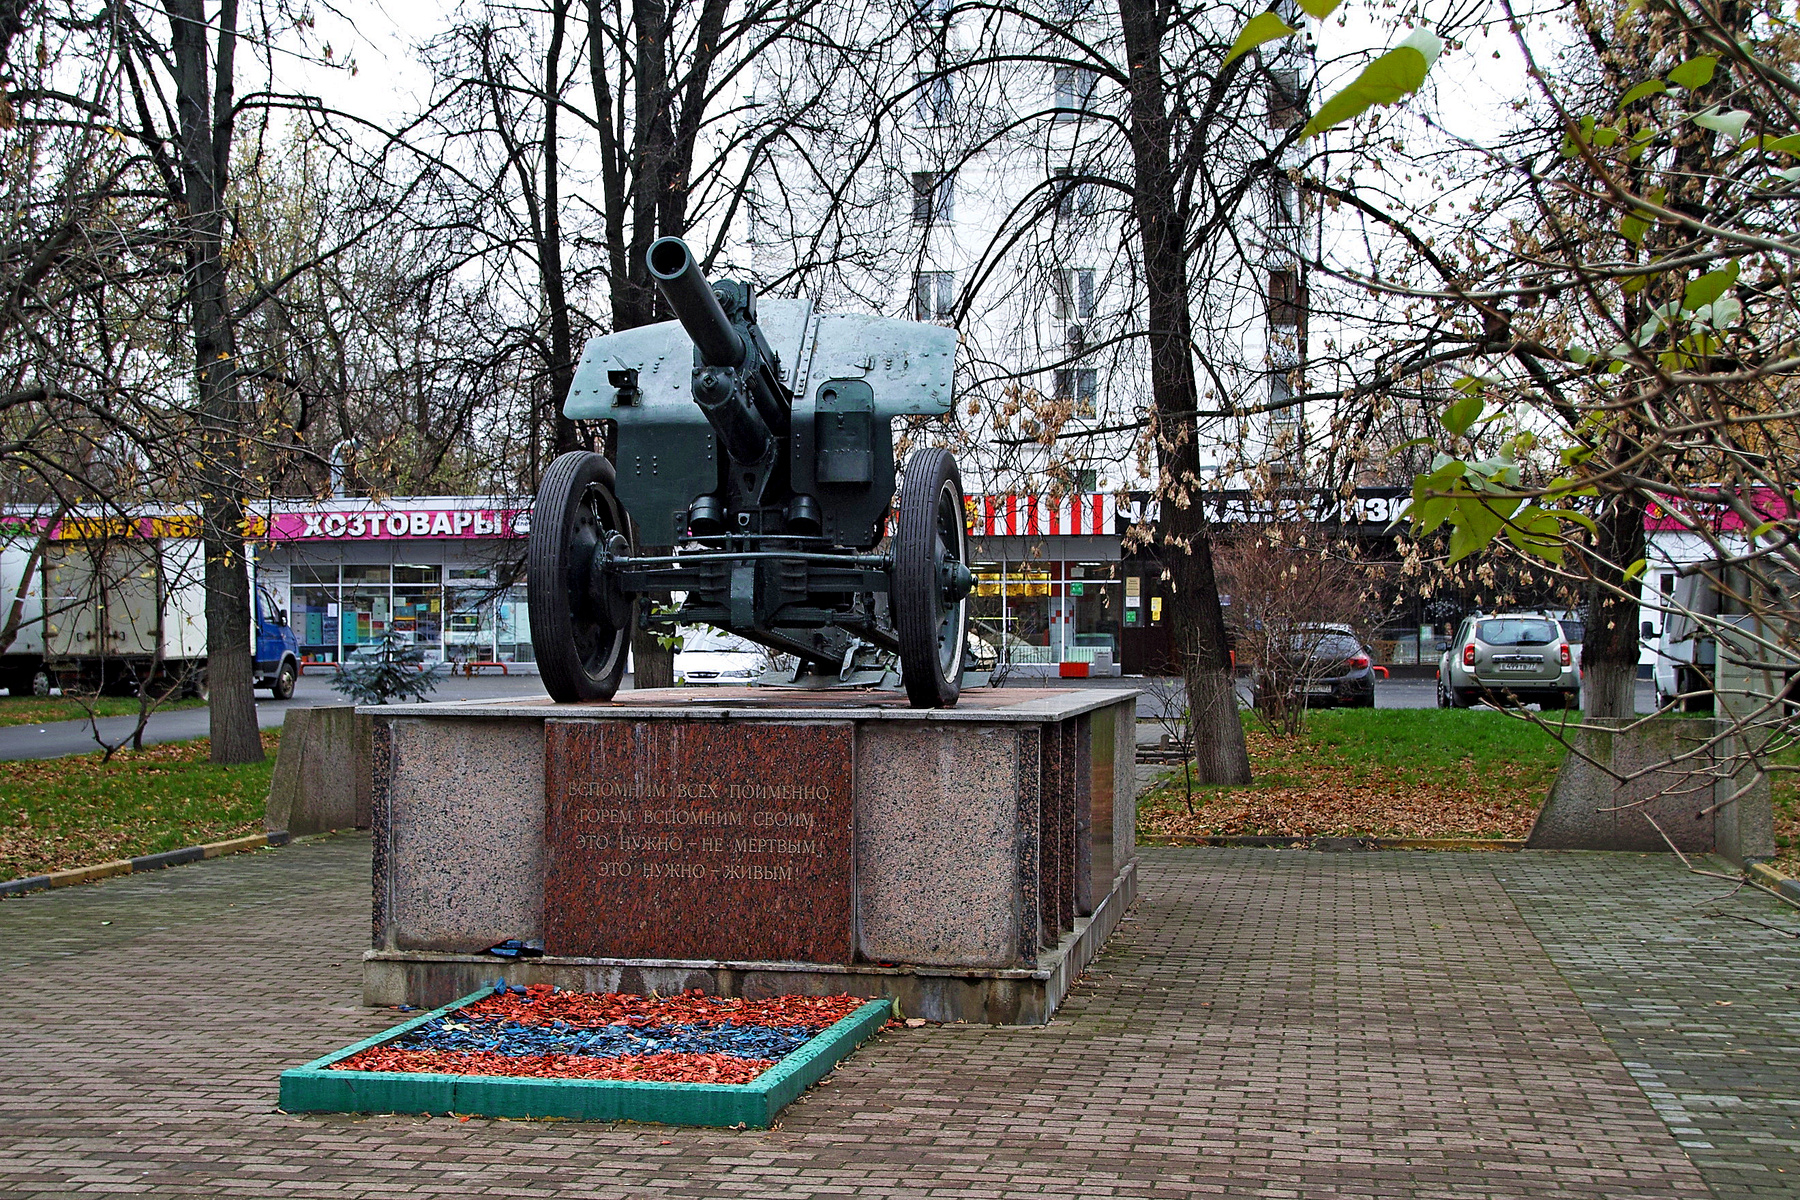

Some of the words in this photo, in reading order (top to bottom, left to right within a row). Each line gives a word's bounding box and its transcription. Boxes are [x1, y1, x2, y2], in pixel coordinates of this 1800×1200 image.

[303, 511, 502, 538] ХОЗТОВАРЫ
[568, 782, 666, 797] ВСПОМНИМ
[677, 783, 718, 798] ВСЕХ
[580, 808, 632, 823] ГОРЕМ
[643, 809, 742, 825] ВСПОМНИМ
[575, 834, 608, 849] ЭТО
[620, 836, 682, 851] НУЖНО
[702, 837, 723, 852] НЕ
[598, 861, 631, 877] ЭТО
[643, 862, 706, 879] НУЖНО
